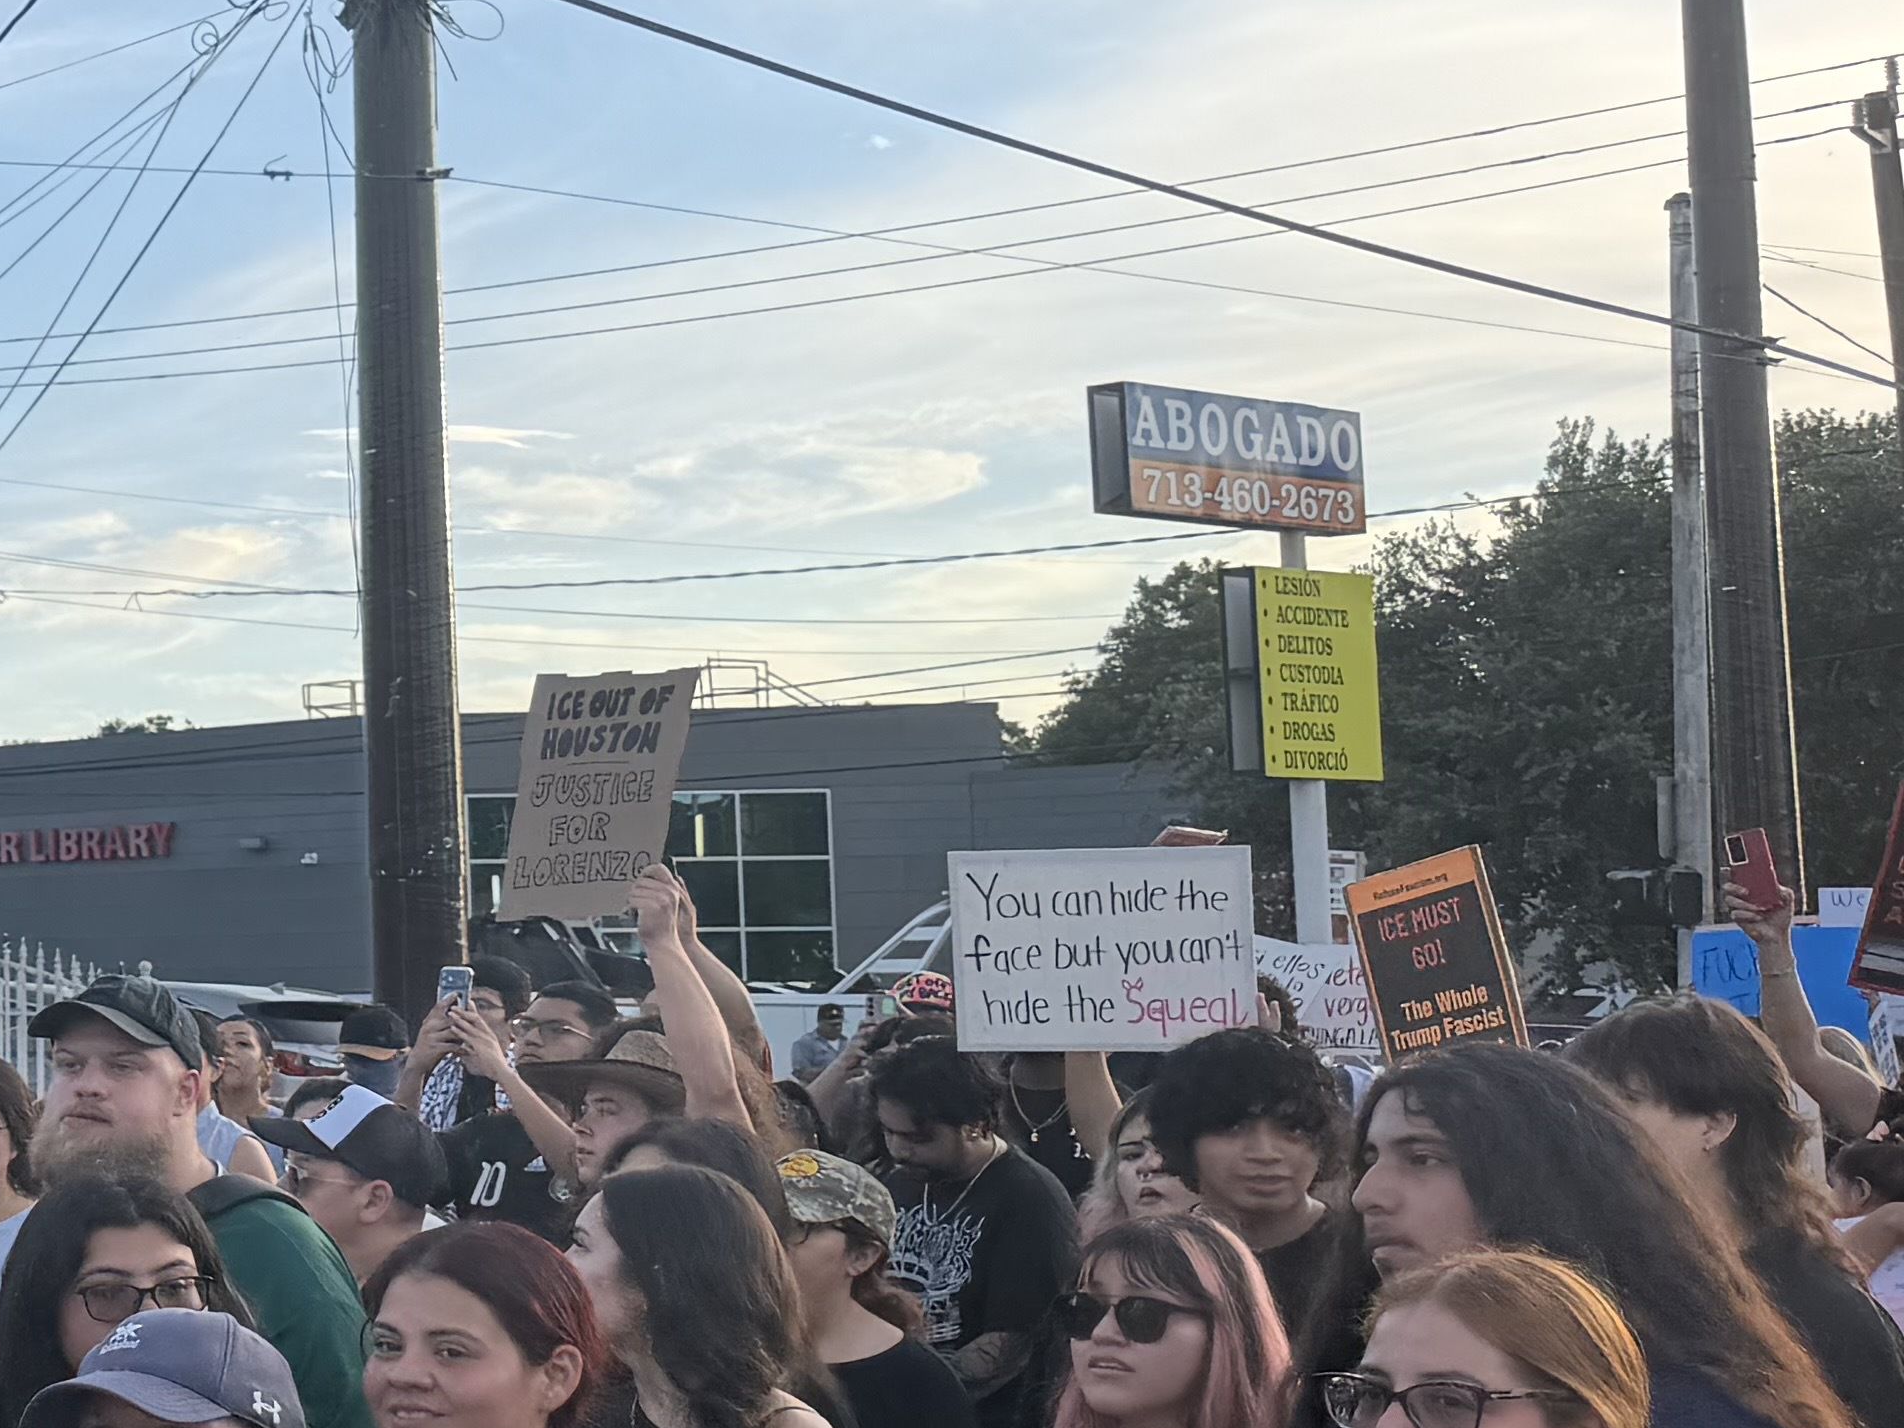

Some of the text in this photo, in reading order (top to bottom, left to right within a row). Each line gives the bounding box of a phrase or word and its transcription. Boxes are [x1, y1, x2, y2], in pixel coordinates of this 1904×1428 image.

[1131, 395, 1361, 472] ABOGADO
[1142, 468, 1355, 525] 713-460-2673
[1274, 573, 1321, 599] LESIÓN
[1275, 606, 1350, 629] ACCIDENTE
[1277, 633, 1333, 656] DELITOS
[1279, 663, 1345, 686] CUSTODIA
[547, 684, 676, 721] ICE OUT OF
[540, 721, 662, 760] HOUSTON
[1282, 720, 1336, 742] DROGAS
[530, 769, 655, 808] JUSTICE
[29, 821, 177, 863] LIBRARY
[548, 811, 611, 847] FOR
[966, 872, 1229, 921] You can hide the
[1378, 897, 1461, 942] ICE MUST
[964, 933, 1042, 976] face
[1054, 935, 1107, 969] but
[1116, 939, 1174, 975] you
[1179, 929, 1243, 964] can't
[1412, 939, 1447, 970] GO!
[982, 989, 1050, 1025] hide
[1063, 984, 1115, 1024] the
[1400, 983, 1489, 1022] The Whole
[1391, 1005, 1507, 1052] Trump Fascist
[471, 1161, 506, 1205] 10
